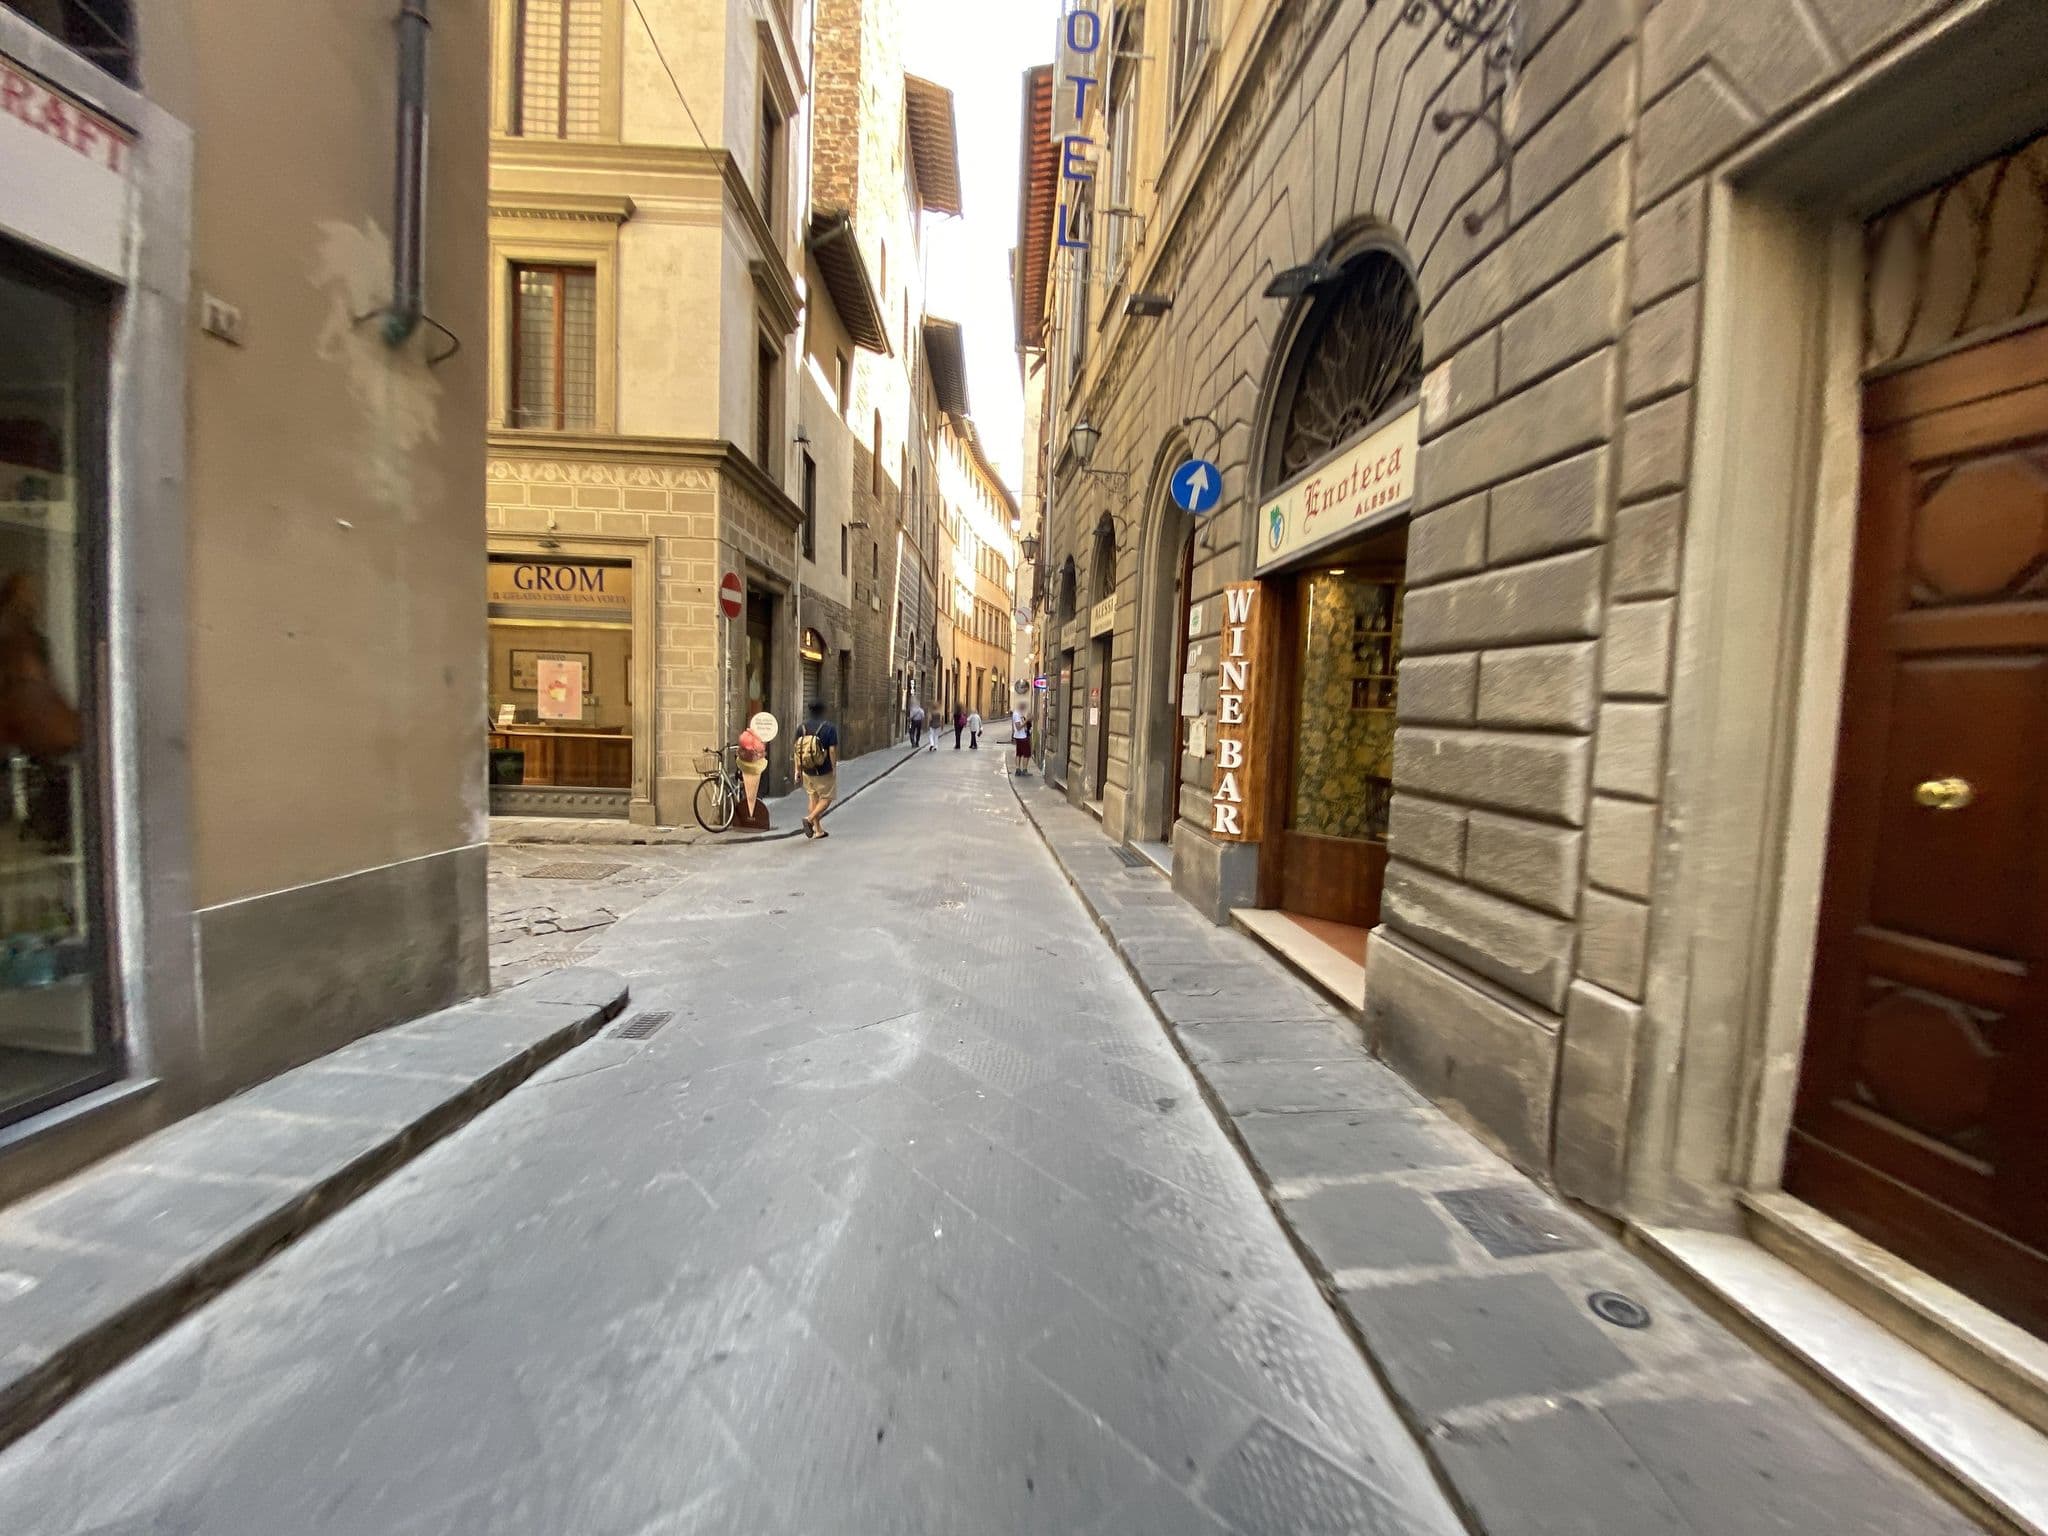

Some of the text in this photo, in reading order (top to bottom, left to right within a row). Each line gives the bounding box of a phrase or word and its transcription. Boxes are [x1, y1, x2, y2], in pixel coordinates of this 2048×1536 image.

[1304, 446, 1402, 534] Enoteca
[1354, 482, 1400, 518] ALESSI
[513, 565, 605, 592] GROM
[1212, 588, 1255, 835] WINE BAR
